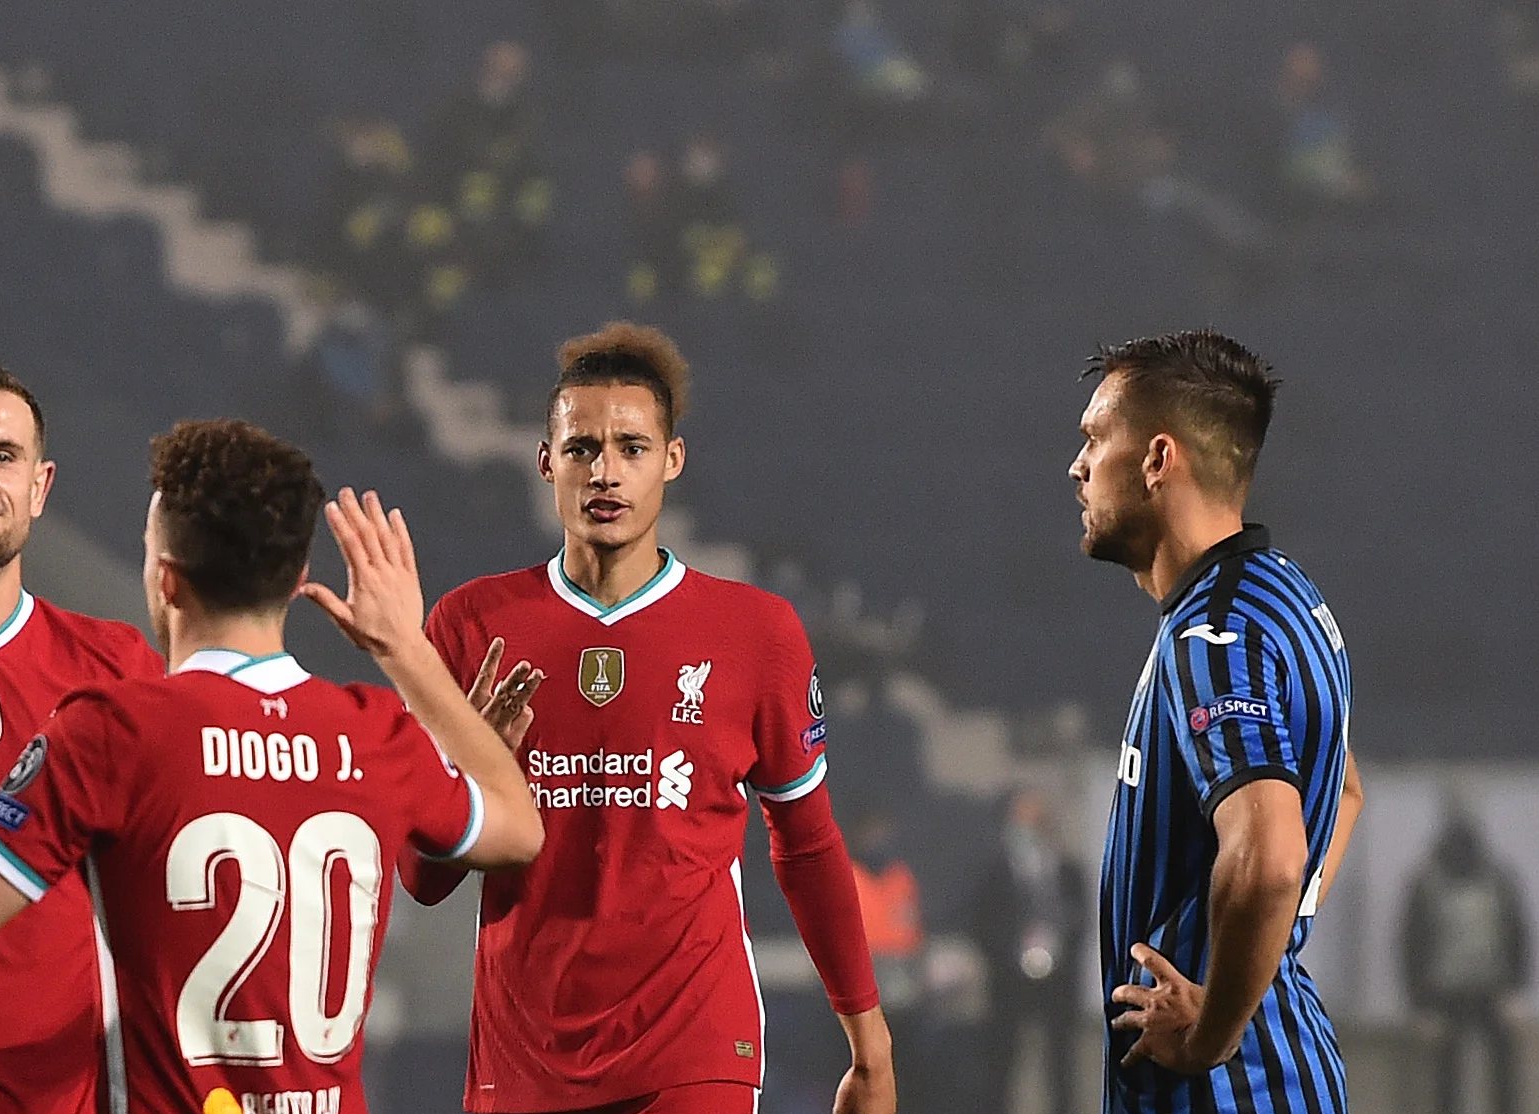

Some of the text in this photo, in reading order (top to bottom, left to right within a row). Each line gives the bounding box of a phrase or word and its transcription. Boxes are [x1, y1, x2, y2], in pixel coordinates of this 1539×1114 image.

[1210, 700, 1268, 718] RESPECT
[201, 726, 364, 781] DIOGO J.
[528, 748, 652, 777] Standard
[528, 782, 652, 809] hartered
[166, 811, 382, 1067] 20
